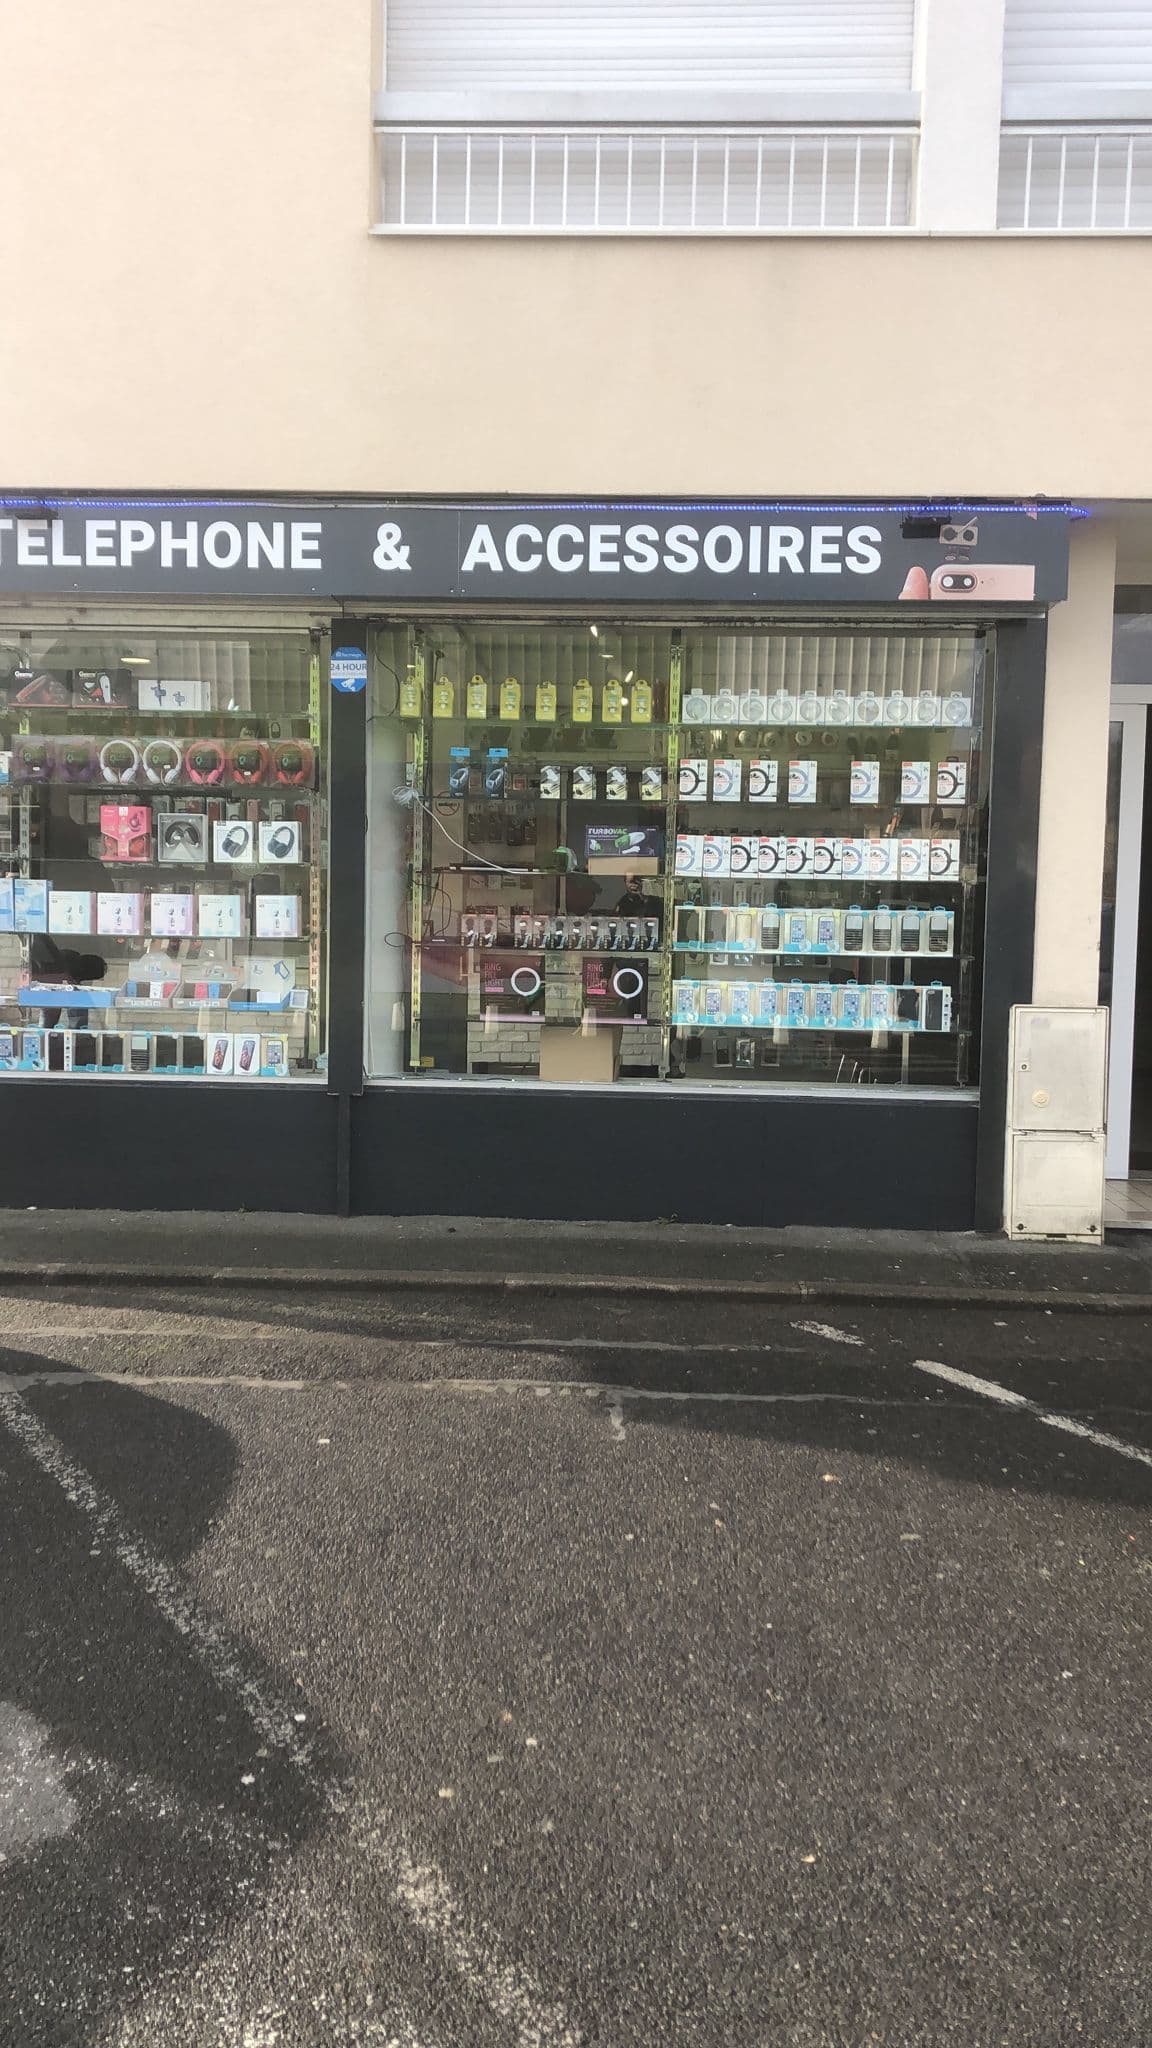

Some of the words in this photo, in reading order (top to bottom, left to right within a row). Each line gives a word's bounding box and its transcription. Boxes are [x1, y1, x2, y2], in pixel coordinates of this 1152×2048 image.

[372, 522, 412, 572] &
[461, 524, 882, 574] ACCESSOIRES
[343, 663, 368, 671] HOUR
